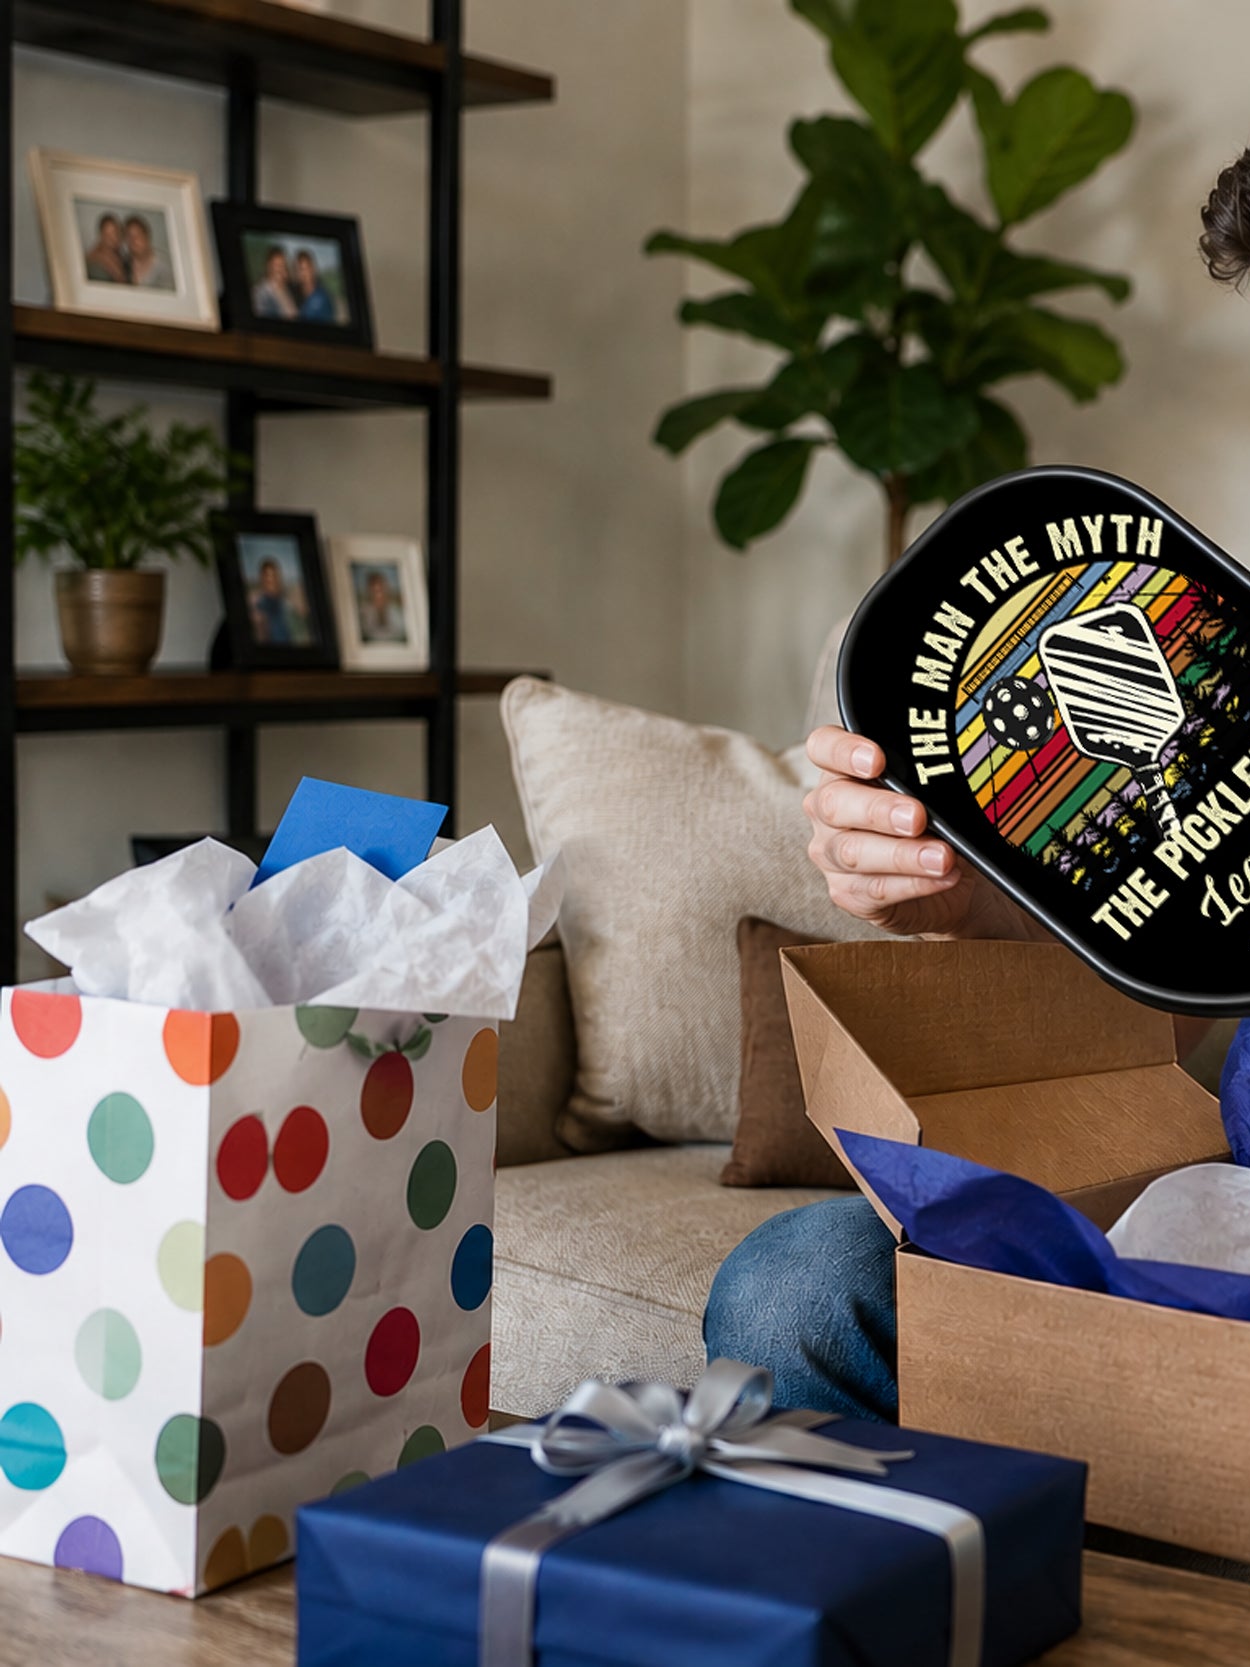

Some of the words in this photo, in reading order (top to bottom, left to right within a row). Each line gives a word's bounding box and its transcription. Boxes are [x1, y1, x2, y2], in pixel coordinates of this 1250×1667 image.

[960, 535, 1040, 603] THE
[1046, 514, 1163, 561] MYTH
[912, 601, 975, 692] MAN
[909, 707, 955, 785] THE
[1091, 868, 1170, 940] THE
